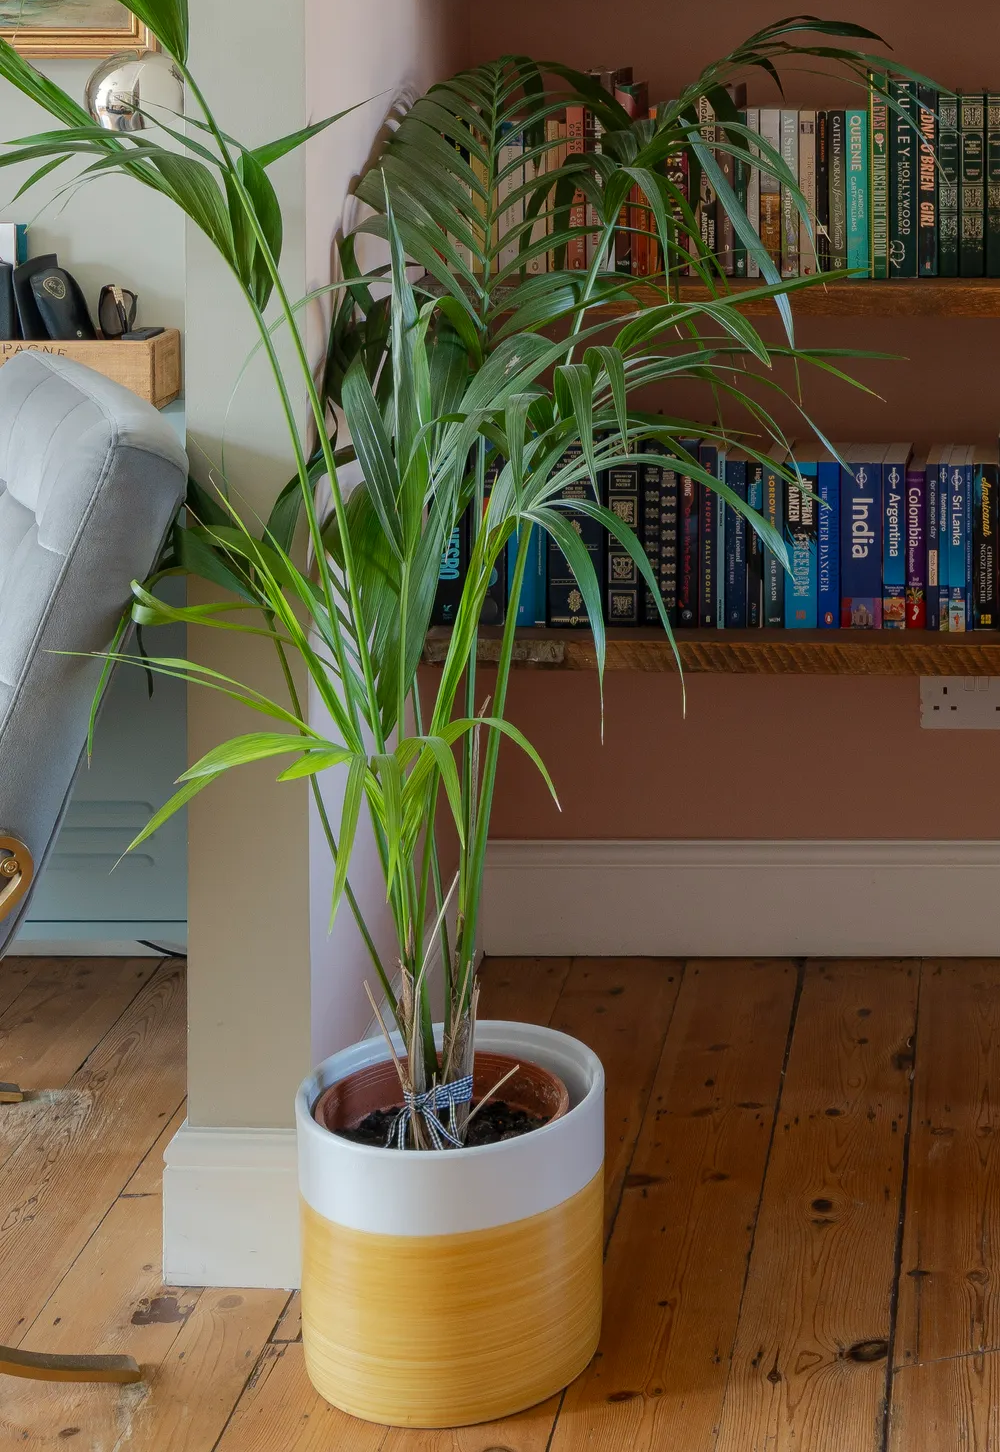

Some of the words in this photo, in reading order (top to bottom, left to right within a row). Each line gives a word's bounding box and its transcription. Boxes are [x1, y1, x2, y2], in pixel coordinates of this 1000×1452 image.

[850, 116, 861, 171] QUEENIE
[902, 162, 910, 235] HOLLYWOOD
[920, 202, 934, 228] GIRL
[852, 498, 874, 558] India
[886, 493, 900, 556] Argentina
[908, 488, 921, 547] Colombia
[953, 495, 962, 510] Sri
[953, 513, 962, 546] Lanka
[981, 477, 992, 537] Americanah
